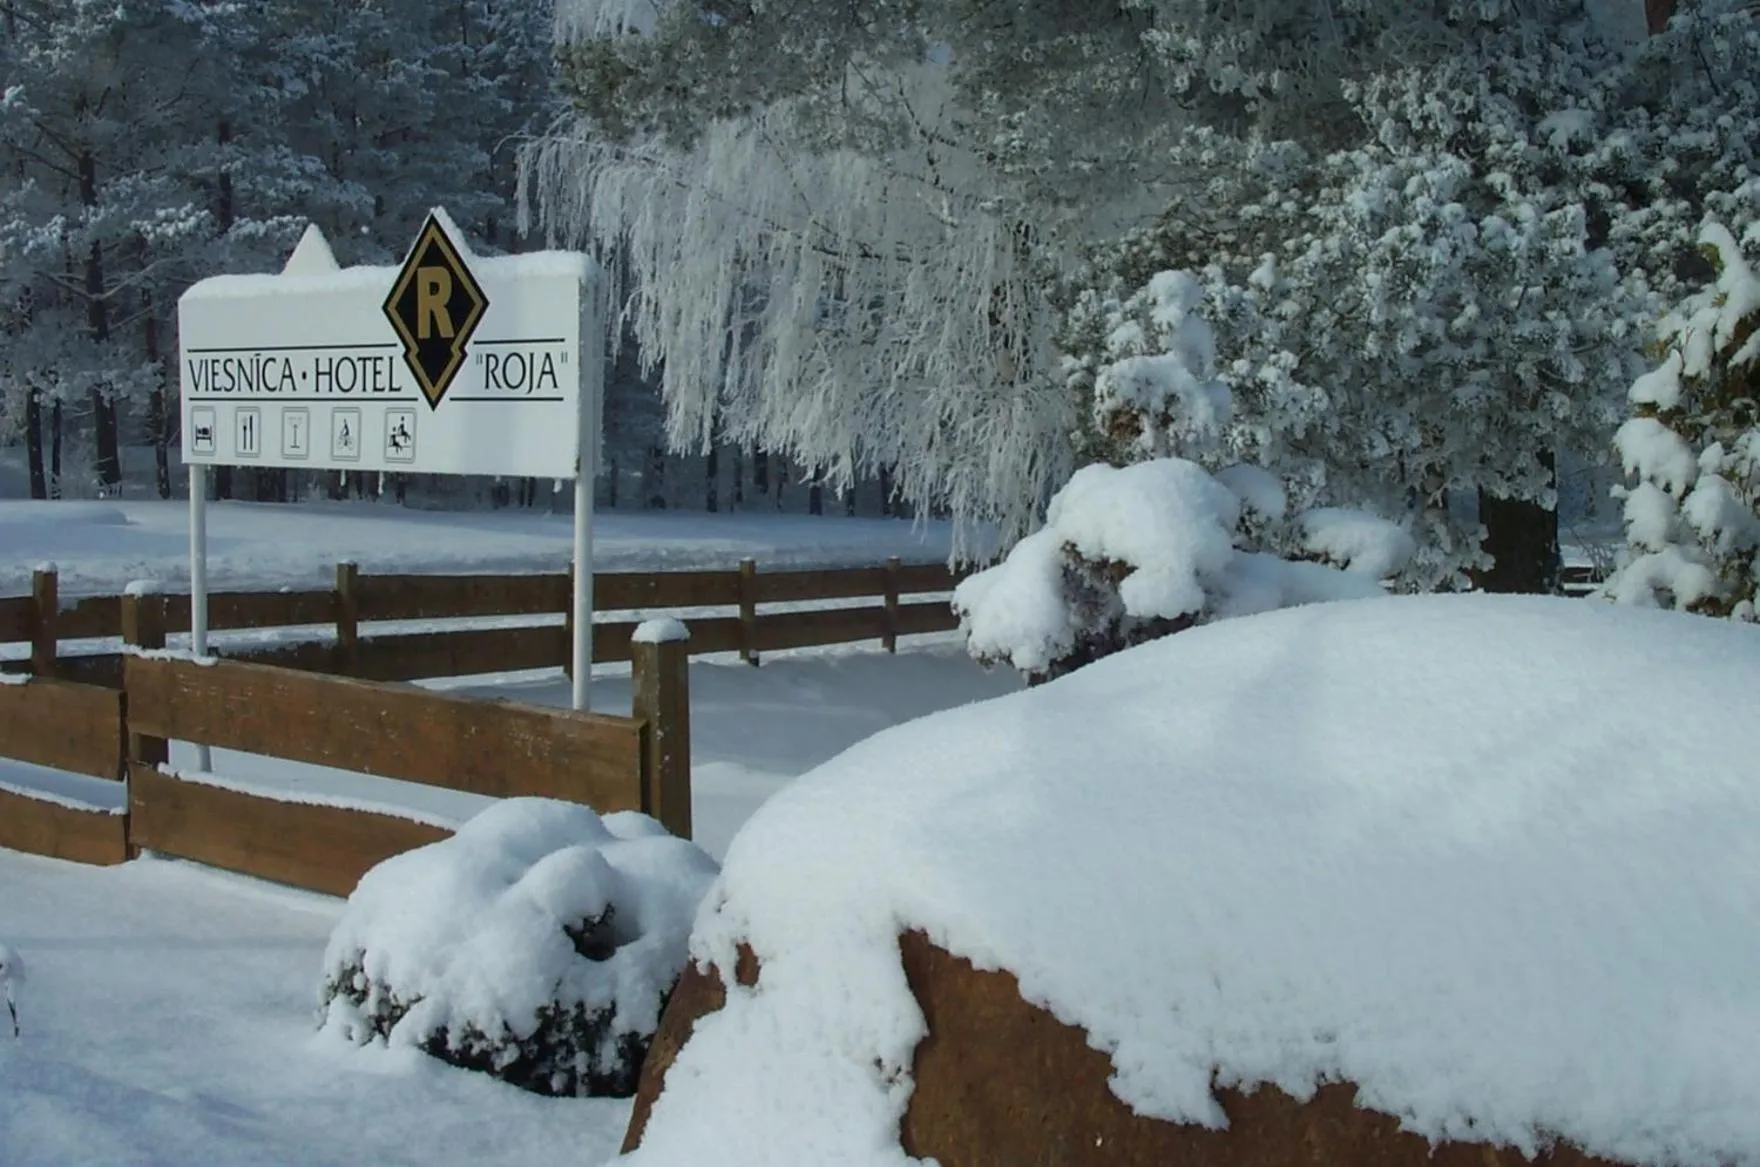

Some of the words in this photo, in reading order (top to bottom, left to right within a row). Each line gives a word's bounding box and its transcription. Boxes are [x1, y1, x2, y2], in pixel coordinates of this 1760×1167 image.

[417, 266, 454, 339] R
[188, 353, 297, 392] VIESNĪCA
[315, 356, 402, 393] HOTEL
[476, 352, 568, 394] "ROJA"
